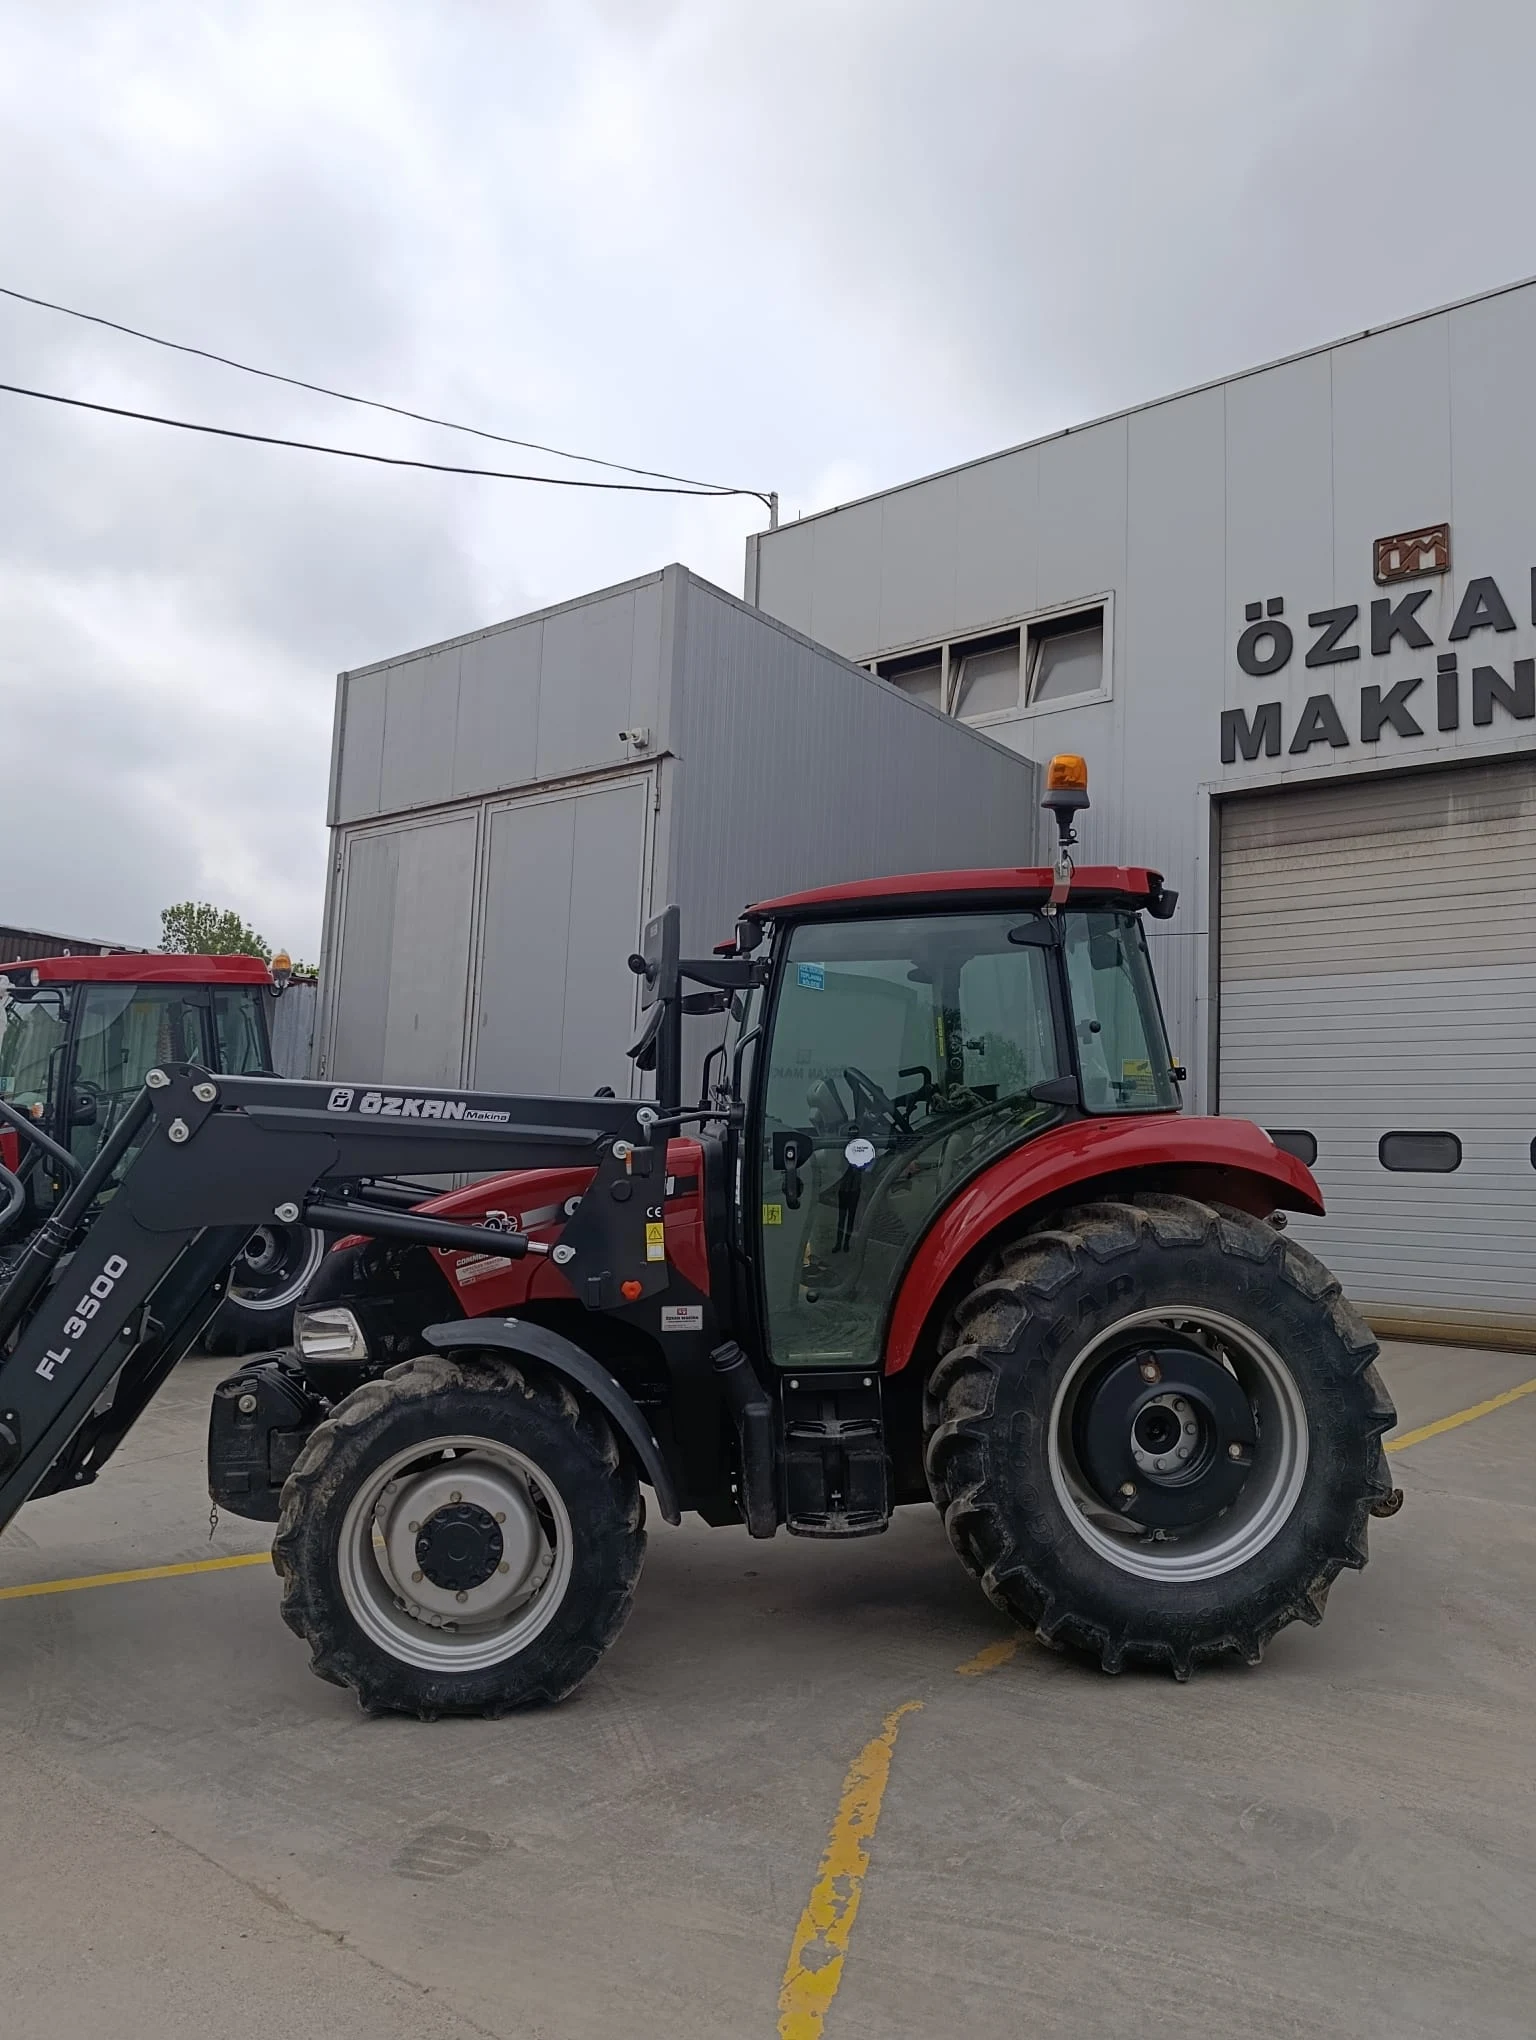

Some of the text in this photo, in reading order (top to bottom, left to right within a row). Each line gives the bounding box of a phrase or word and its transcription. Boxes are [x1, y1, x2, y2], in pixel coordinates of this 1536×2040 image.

[1236, 566, 1536, 677] ÖZKA
[1220, 652, 1535, 764] MAKİN
[359, 1091, 467, 1120] ÖZKAN
[465, 1111, 508, 1121] Makina
[646, 1206, 662, 1218] CE
[35, 1254, 128, 1381] FL 3500
